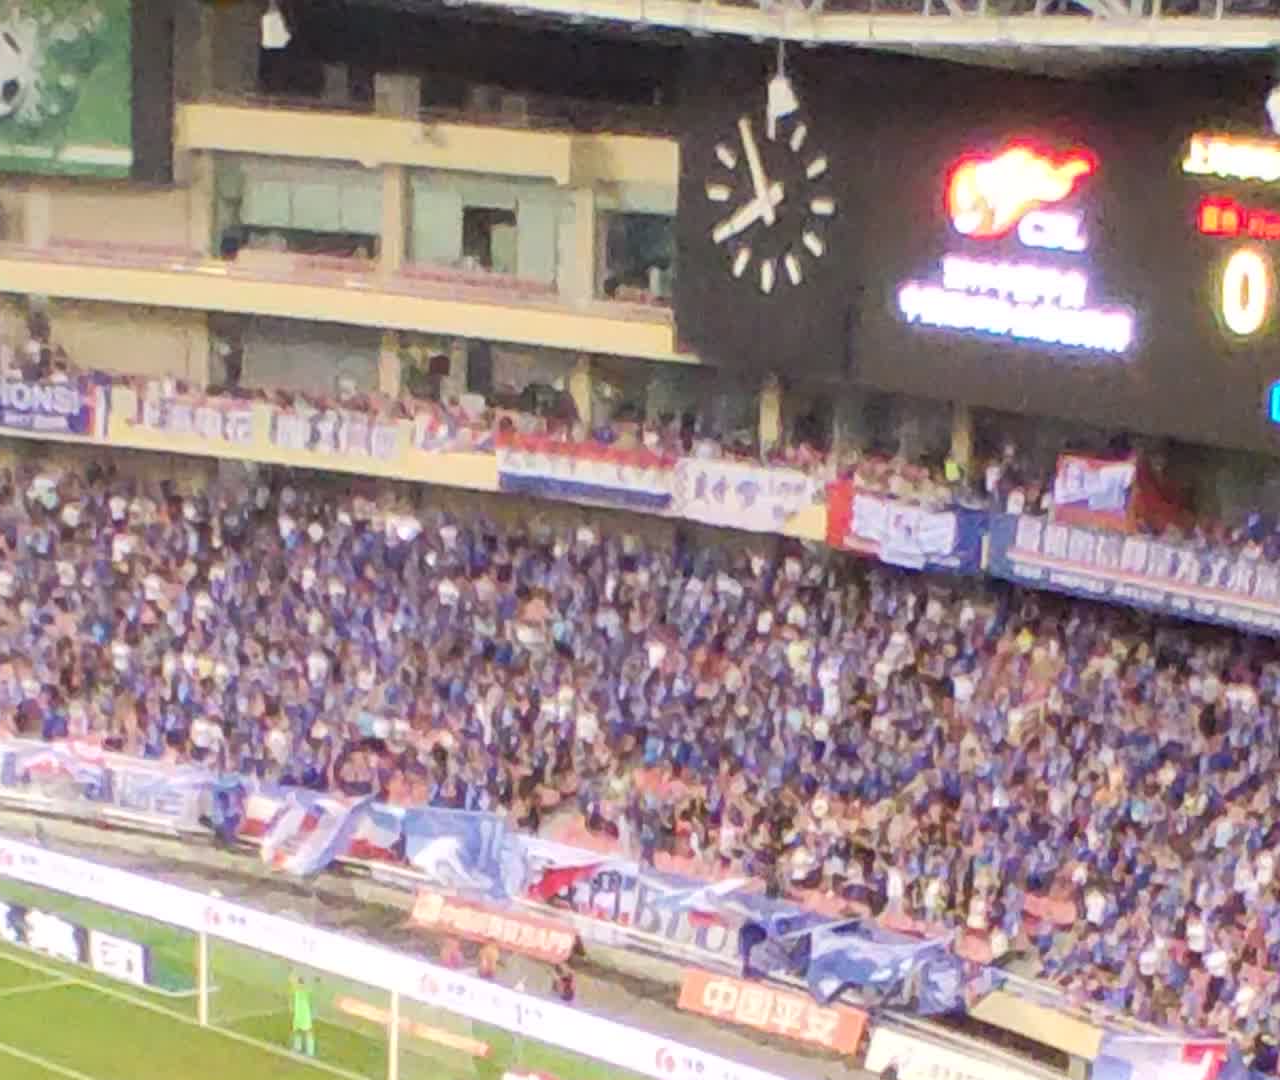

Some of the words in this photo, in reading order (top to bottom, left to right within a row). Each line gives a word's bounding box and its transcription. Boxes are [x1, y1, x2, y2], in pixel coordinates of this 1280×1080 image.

[1222, 247, 1268, 336] 0
[702, 979, 846, 1048] 中国平安
